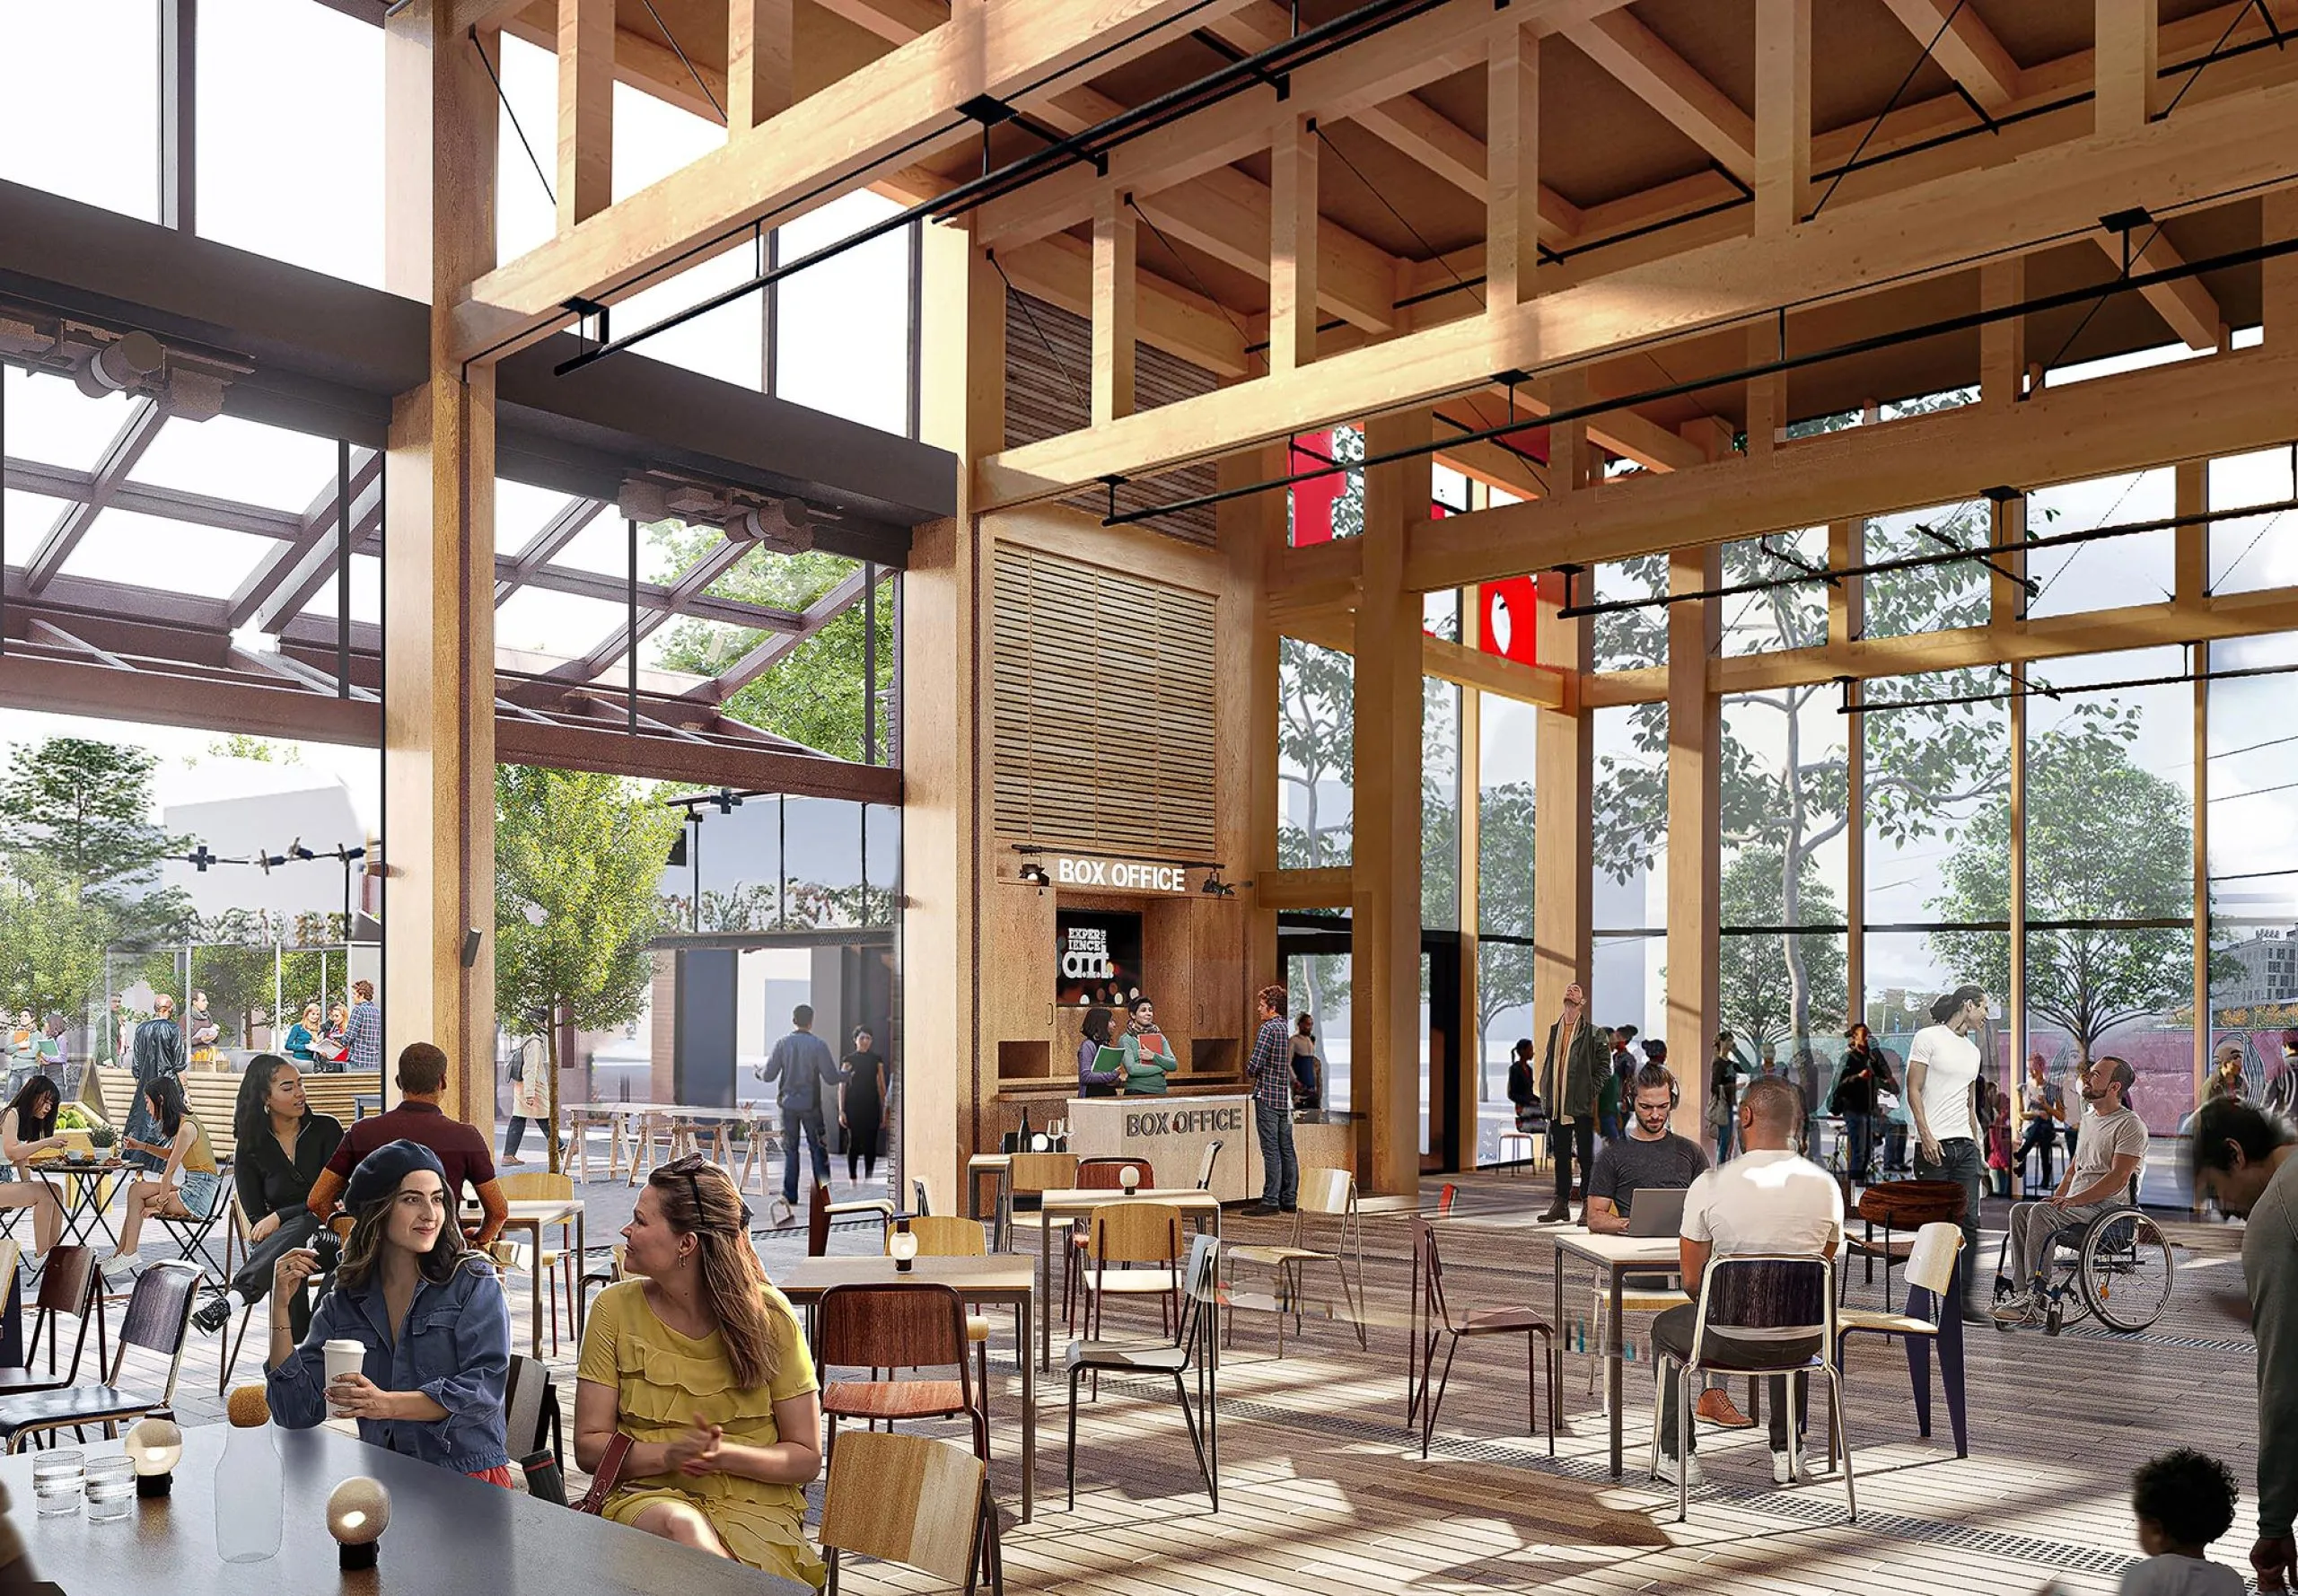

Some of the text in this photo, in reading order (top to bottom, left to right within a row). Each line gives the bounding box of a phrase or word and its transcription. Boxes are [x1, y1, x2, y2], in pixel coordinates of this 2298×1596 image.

[1059, 858, 1186, 891] BOX OFFICE
[1068, 927, 1101, 940] EXPER
[1068, 940, 1101, 951] IENCE
[1127, 1108, 1242, 1136] BOX OFFICE
